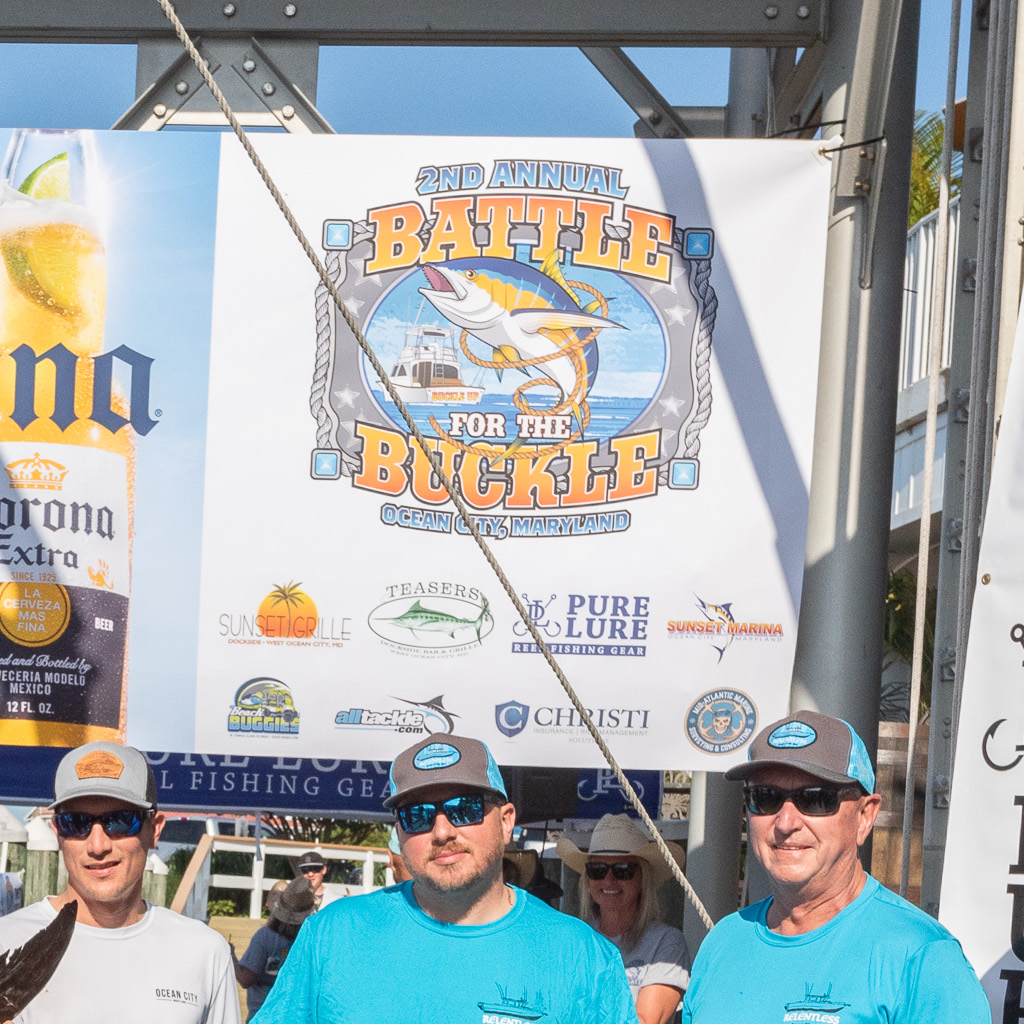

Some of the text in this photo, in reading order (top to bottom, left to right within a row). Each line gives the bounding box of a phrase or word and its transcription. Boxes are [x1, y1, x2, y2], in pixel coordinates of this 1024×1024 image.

[415, 159, 631, 200] 2ND ANNUAL
[365, 194, 677, 285] BATTLE
[449, 412, 572, 440] FOR THE
[352, 419, 662, 511] BUCKLE
[380, 502, 454, 534] OCEAN
[510, 509, 632, 538] MARYLAND
[10, 571, 35, 581] SINCE
[24, 588, 41, 598] LA
[386, 581, 481, 601] TEASERS
[3, 598, 61, 611] CERVEZA
[567, 594, 650, 618] PURE
[18, 611, 46, 621] MAS
[94, 617, 115, 632] BEER
[17, 622, 46, 633] FINA
[219, 613, 352, 641] SUNSET GRILLE
[565, 617, 648, 640] LURE
[667, 620, 783, 637] SUNSET MARINA
[513, 643, 645, 656] REE FISHING GEAR
[11, 654, 35, 667] and
[35, 654, 78, 671] Bottled
[78, 659, 93, 675] by
[44, 673, 86, 686] MODELO
[9, 683, 52, 696] MEXICO
[6, 701, 55, 714] 12 FL. OZ.
[229, 705, 264, 717] Beach
[692, 690, 734, 715] MID-ATLANTIC
[228, 715, 300, 734] BUGGIES
[335, 708, 424, 727] alltackle
[394, 726, 424, 734] .com
[190, 771, 320, 796] FISHING
[155, 988, 182, 999] OCEAN
[183, 991, 198, 1003] CITY
[783, 1012, 840, 1024] RELENTLESS
